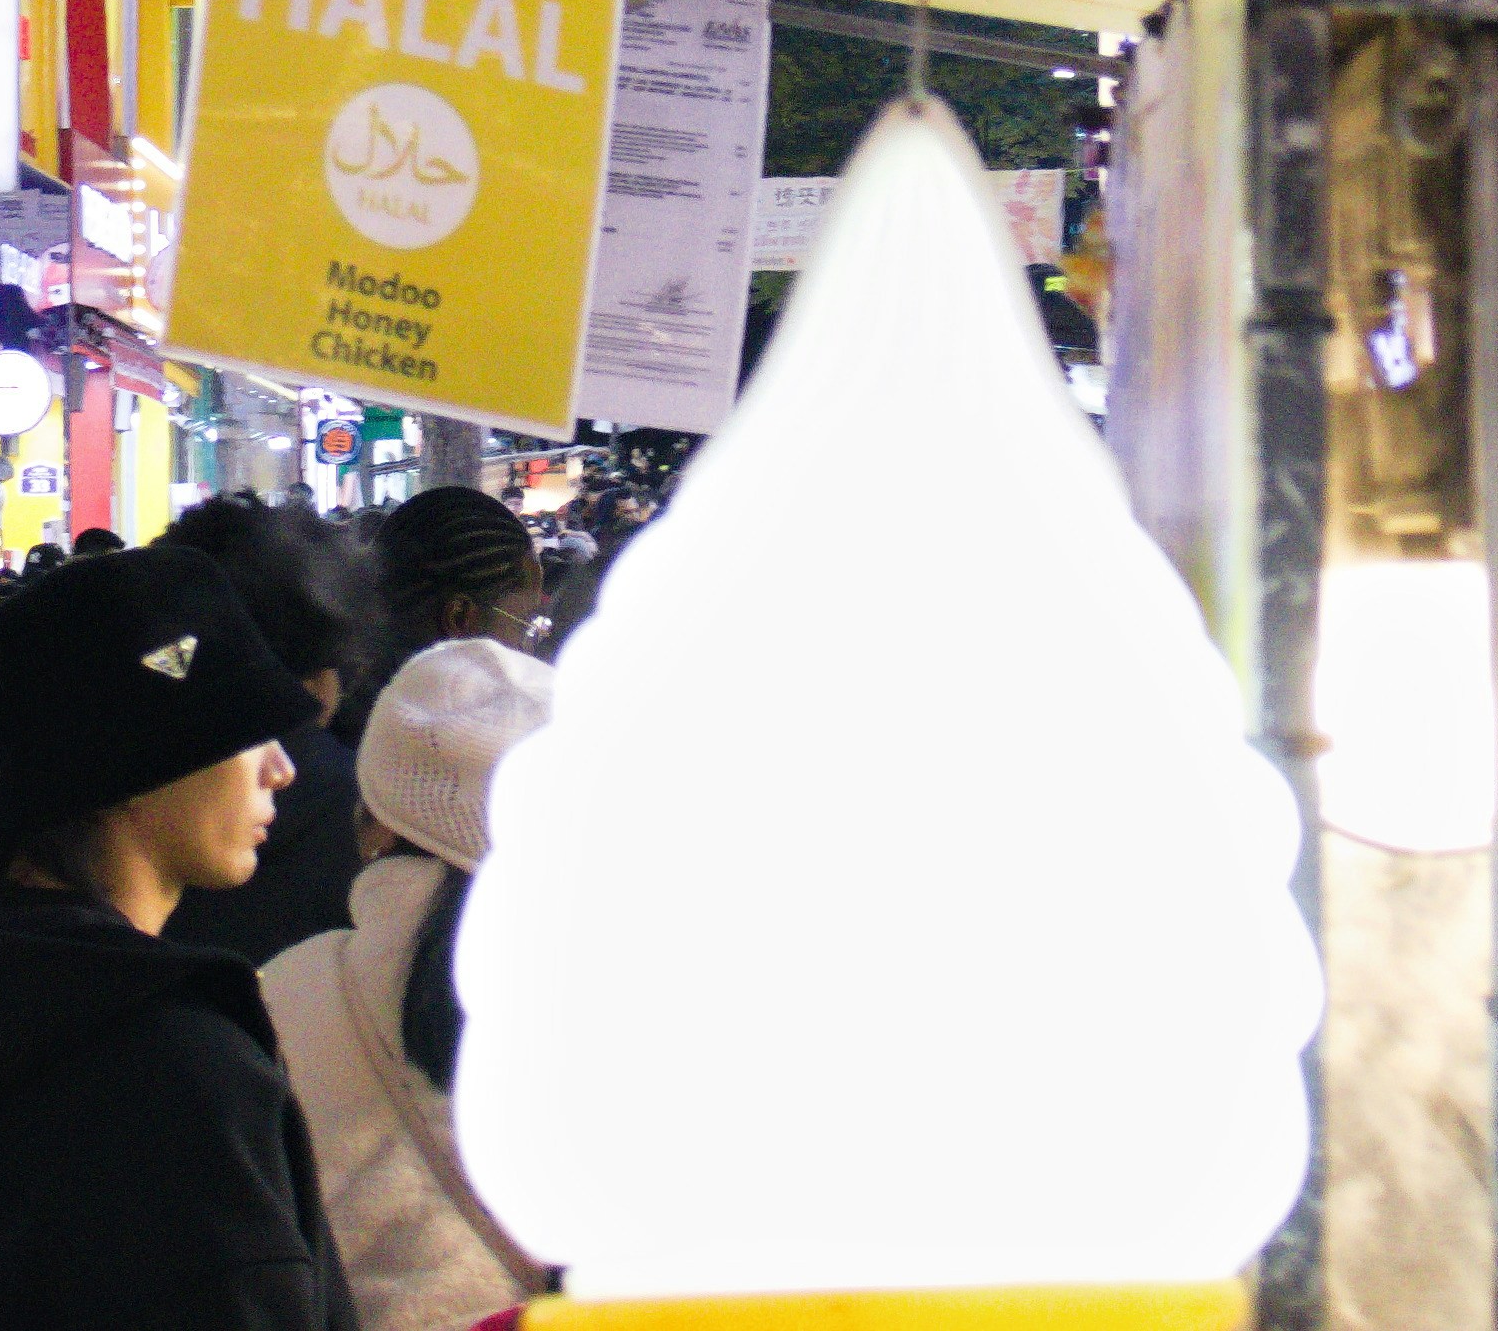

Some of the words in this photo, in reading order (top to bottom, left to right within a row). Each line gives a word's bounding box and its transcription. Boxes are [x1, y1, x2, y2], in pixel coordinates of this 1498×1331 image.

[325, 259, 442, 310] Modoo
[325, 297, 432, 349] Honey
[309, 331, 441, 382] Chicken
